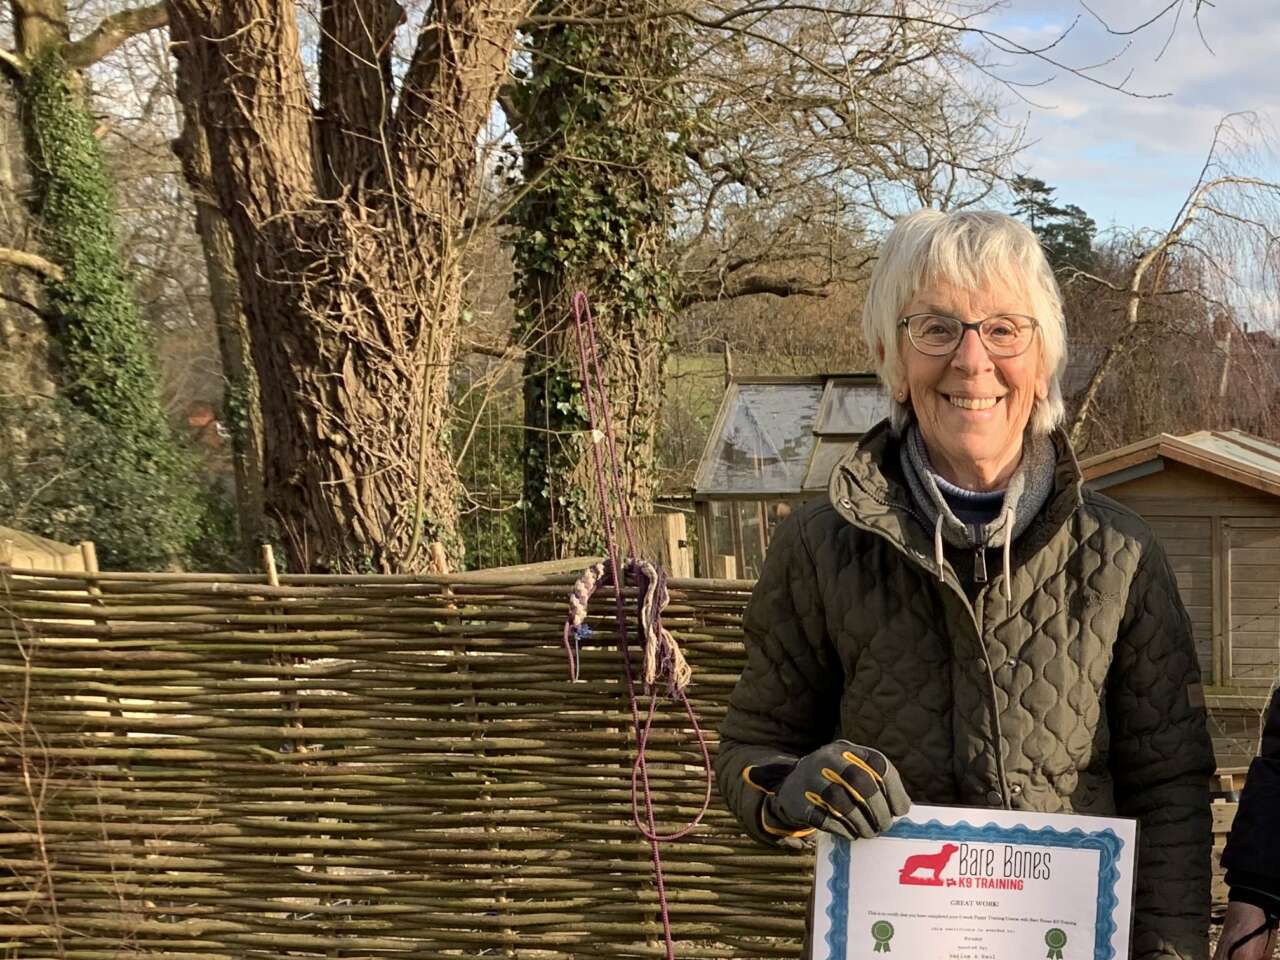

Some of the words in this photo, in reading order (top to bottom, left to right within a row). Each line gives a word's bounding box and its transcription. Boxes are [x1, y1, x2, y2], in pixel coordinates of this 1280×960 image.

[959, 843, 994, 876] Bare
[1004, 845, 1051, 880] Bones
[958, 878, 972, 888] K9
[976, 879, 1024, 891] TRAINING
